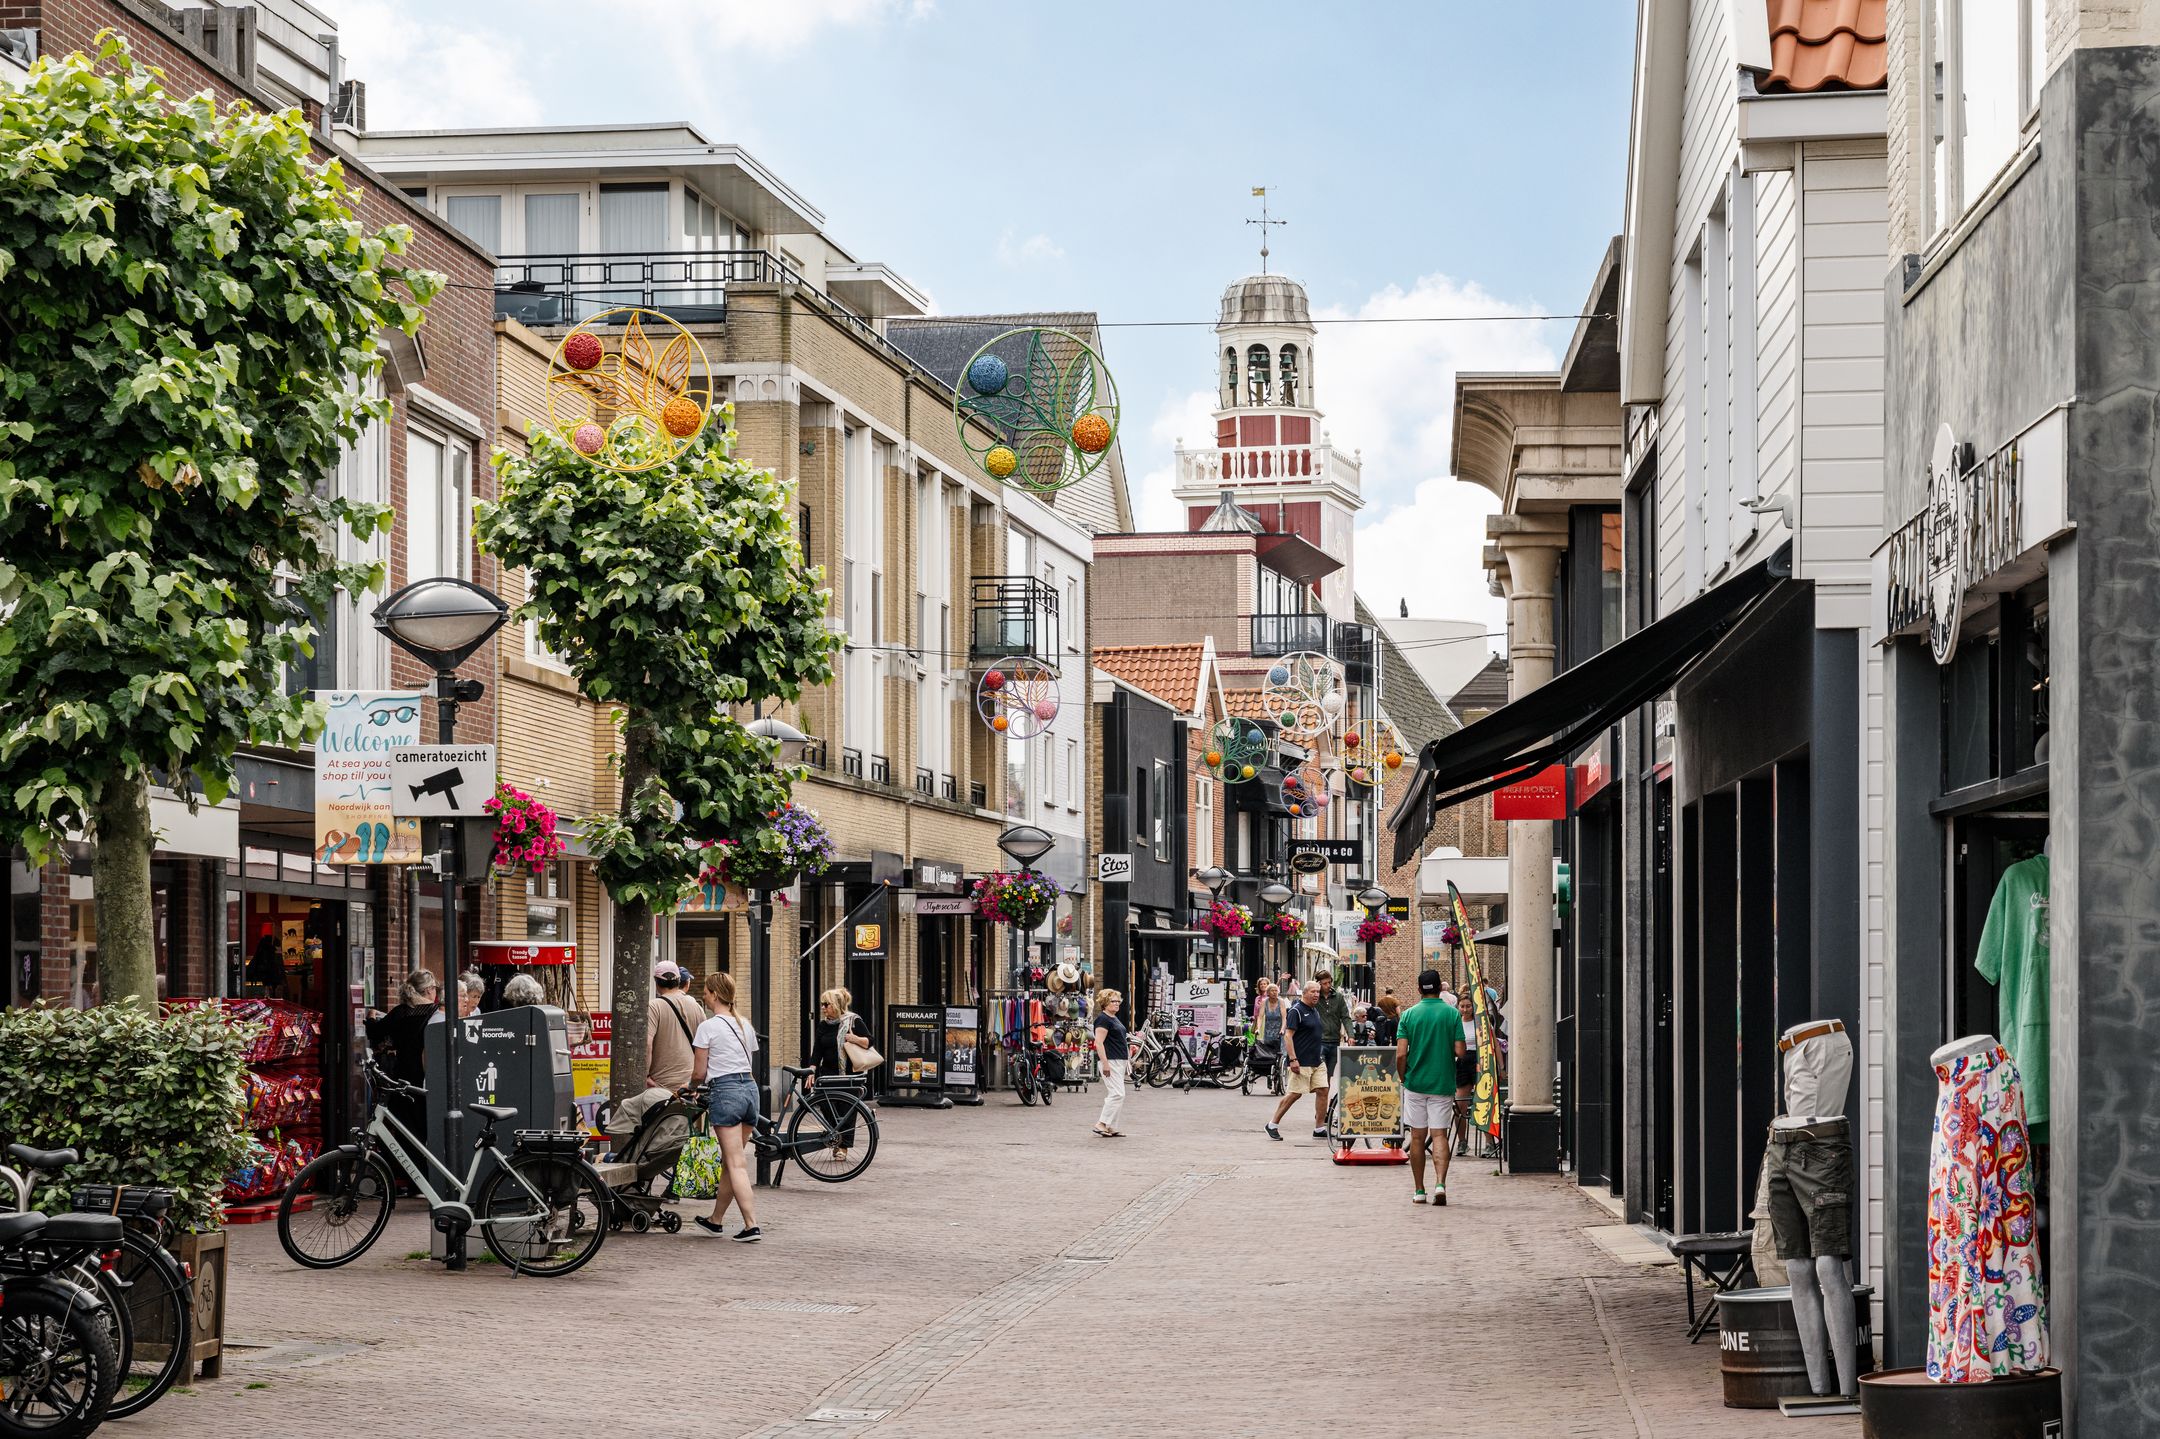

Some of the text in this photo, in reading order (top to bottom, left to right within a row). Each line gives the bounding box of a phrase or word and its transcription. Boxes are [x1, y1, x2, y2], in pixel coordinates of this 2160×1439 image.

[321, 723, 417, 753] Welcome
[395, 750, 488, 763] cameratoezicht
[328, 760, 340, 768] At
[362, 762, 382, 771] you
[322, 771, 386, 782] shop till you
[328, 803, 371, 812] Noordwijk
[1340, 847, 1353, 857] CO
[1101, 856, 1129, 873] Etos
[1189, 984, 1210, 996] Etos
[896, 1012, 938, 1020] MENUKAART
[592, 1016, 611, 1030] rui
[482, 1031, 515, 1039] Noordwijk
[953, 1048, 973, 1064] 3+1
[952, 1064, 973, 1072] GRATIS
[389, 1142, 421, 1181] GAZELLE
[1720, 1330, 1750, 1352] ONE
[76, 1353, 98, 1420] KENDA
